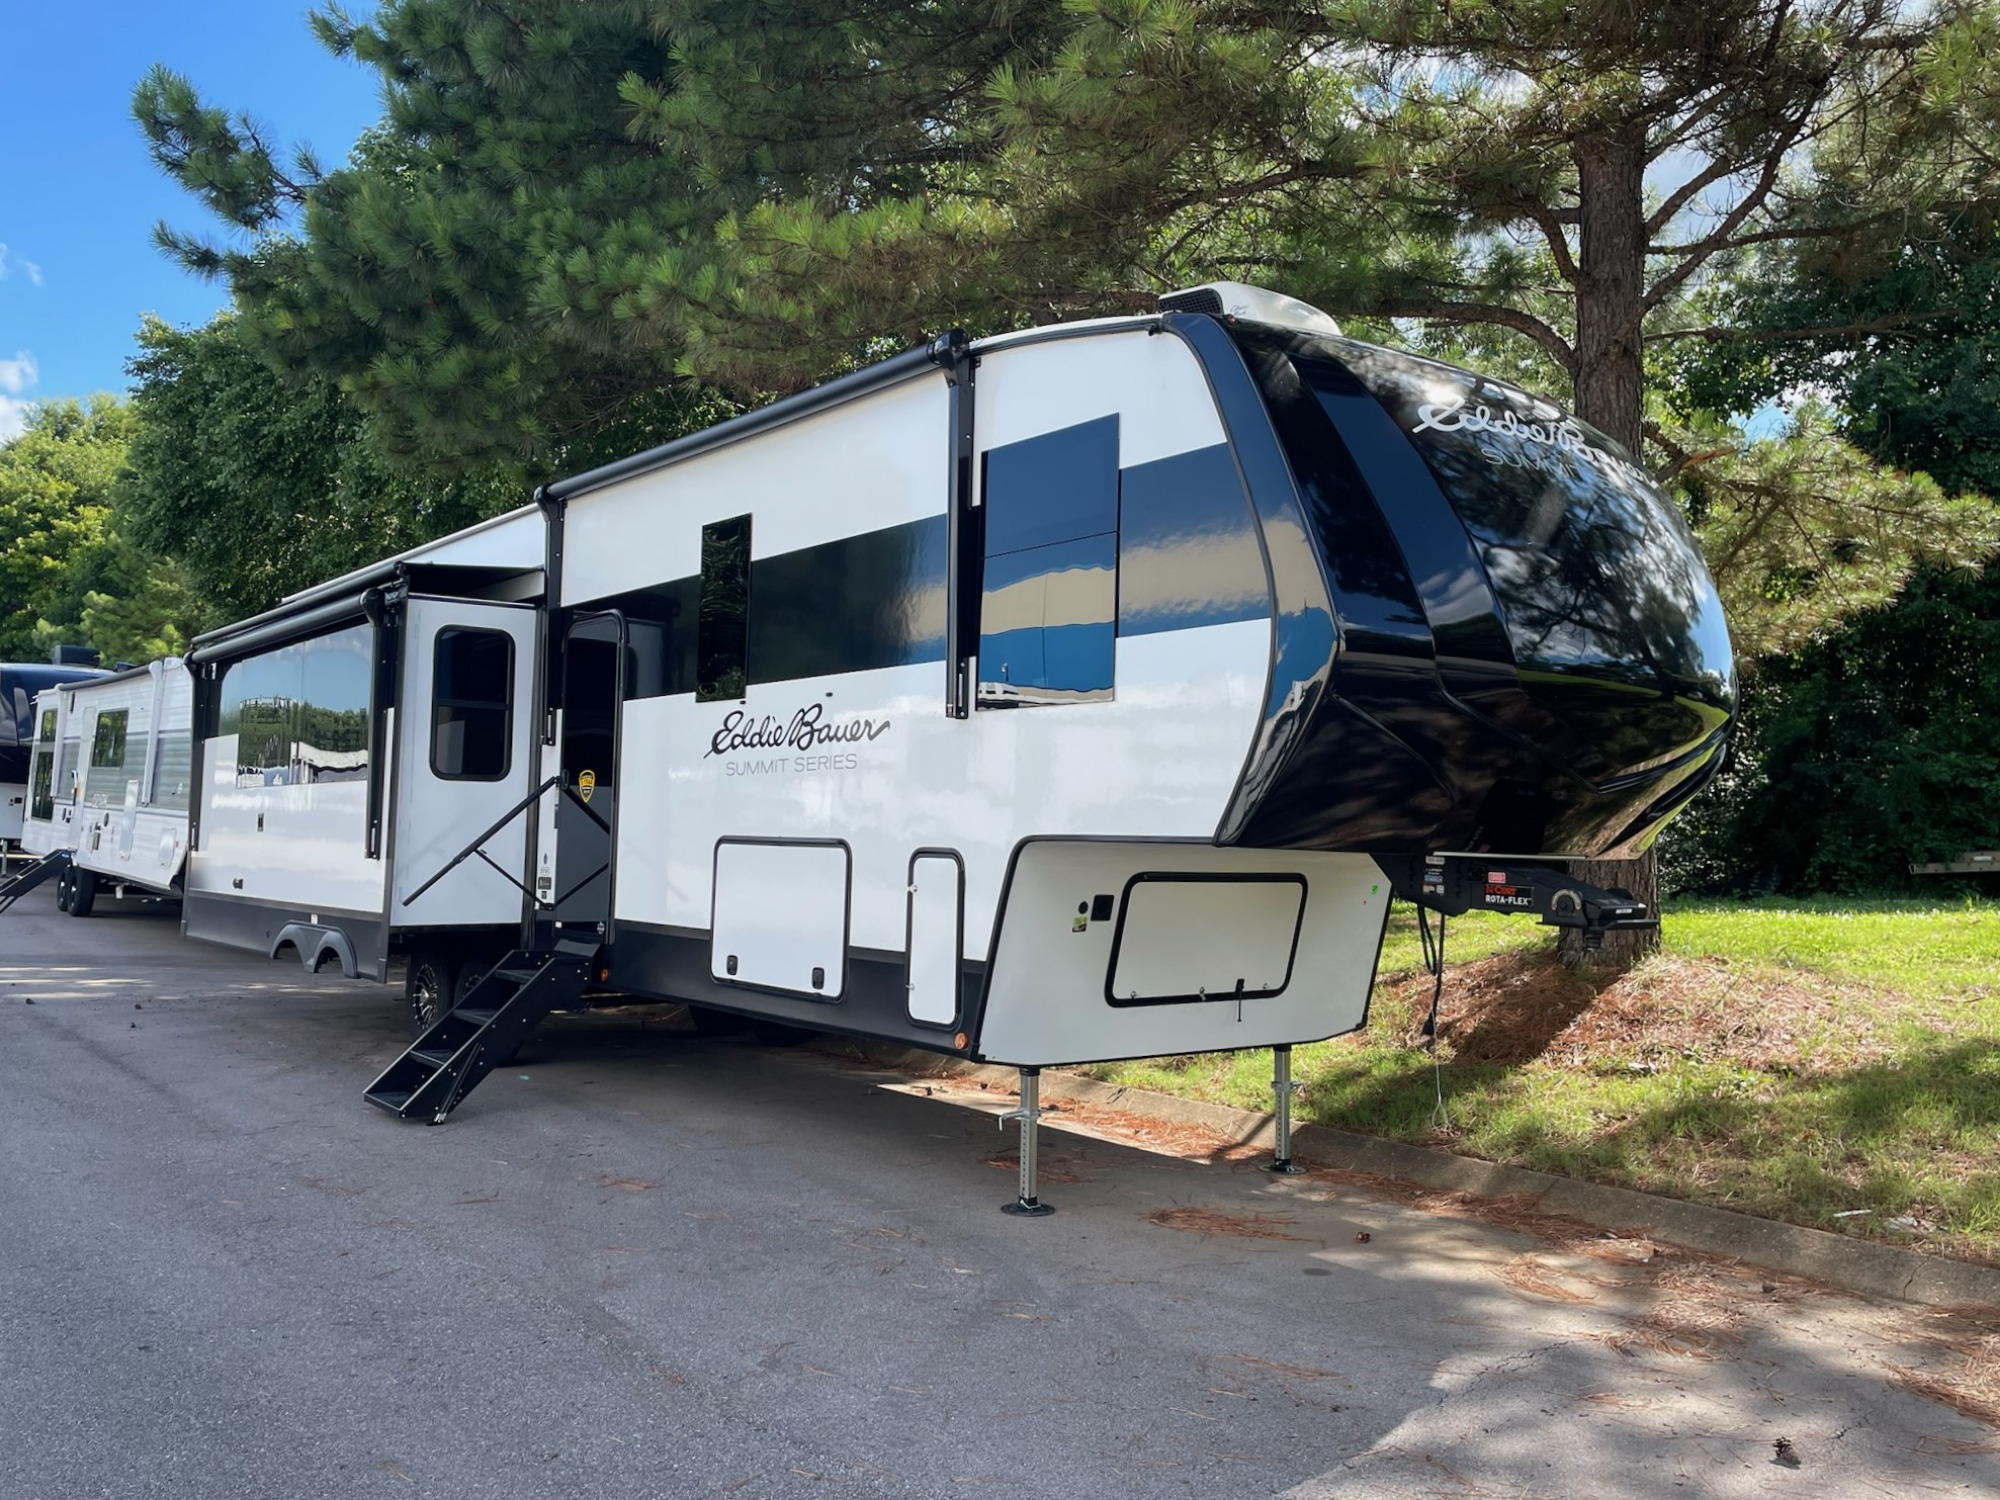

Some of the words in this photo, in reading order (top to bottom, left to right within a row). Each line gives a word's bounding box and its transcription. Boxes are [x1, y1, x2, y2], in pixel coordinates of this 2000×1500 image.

[1411, 392, 1554, 446] Eddie
[703, 710, 789, 759] Eddie
[787, 703, 891, 751] Bauer
[725, 757, 790, 777] SUMMIT
[793, 752, 858, 773] SERIES
